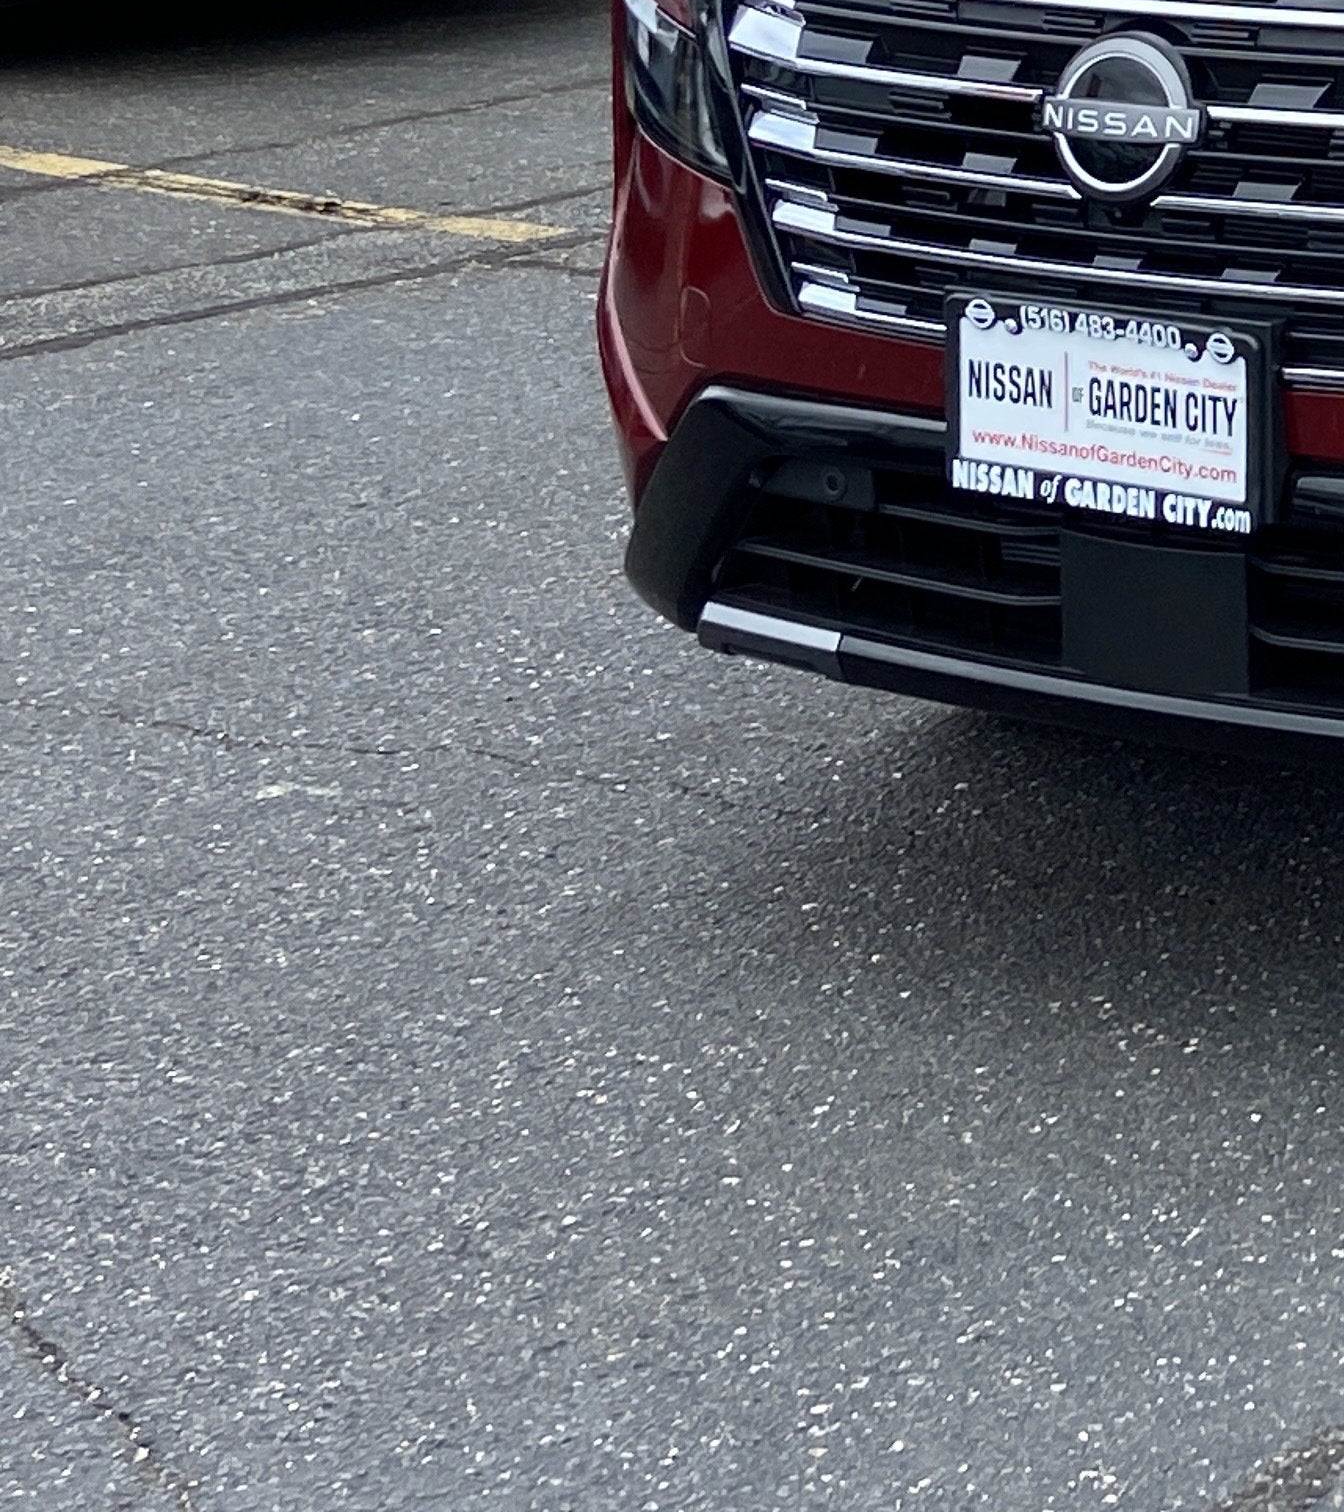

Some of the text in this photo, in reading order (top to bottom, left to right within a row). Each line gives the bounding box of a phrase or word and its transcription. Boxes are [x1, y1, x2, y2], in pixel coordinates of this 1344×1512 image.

[1043, 102, 1193, 139] NISSAN
[1020, 304, 1182, 351] (516) 483-4400
[968, 358, 1053, 409] NISSAN
[1089, 376, 1178, 429] GARDEN
[1185, 391, 1238, 438] CITY
[972, 429, 1238, 484] www.NissanofGardenCity.com
[952, 458, 1035, 500] NISSAN
[1040, 474, 1063, 504] of
[1064, 477, 1156, 520] GARDEN
